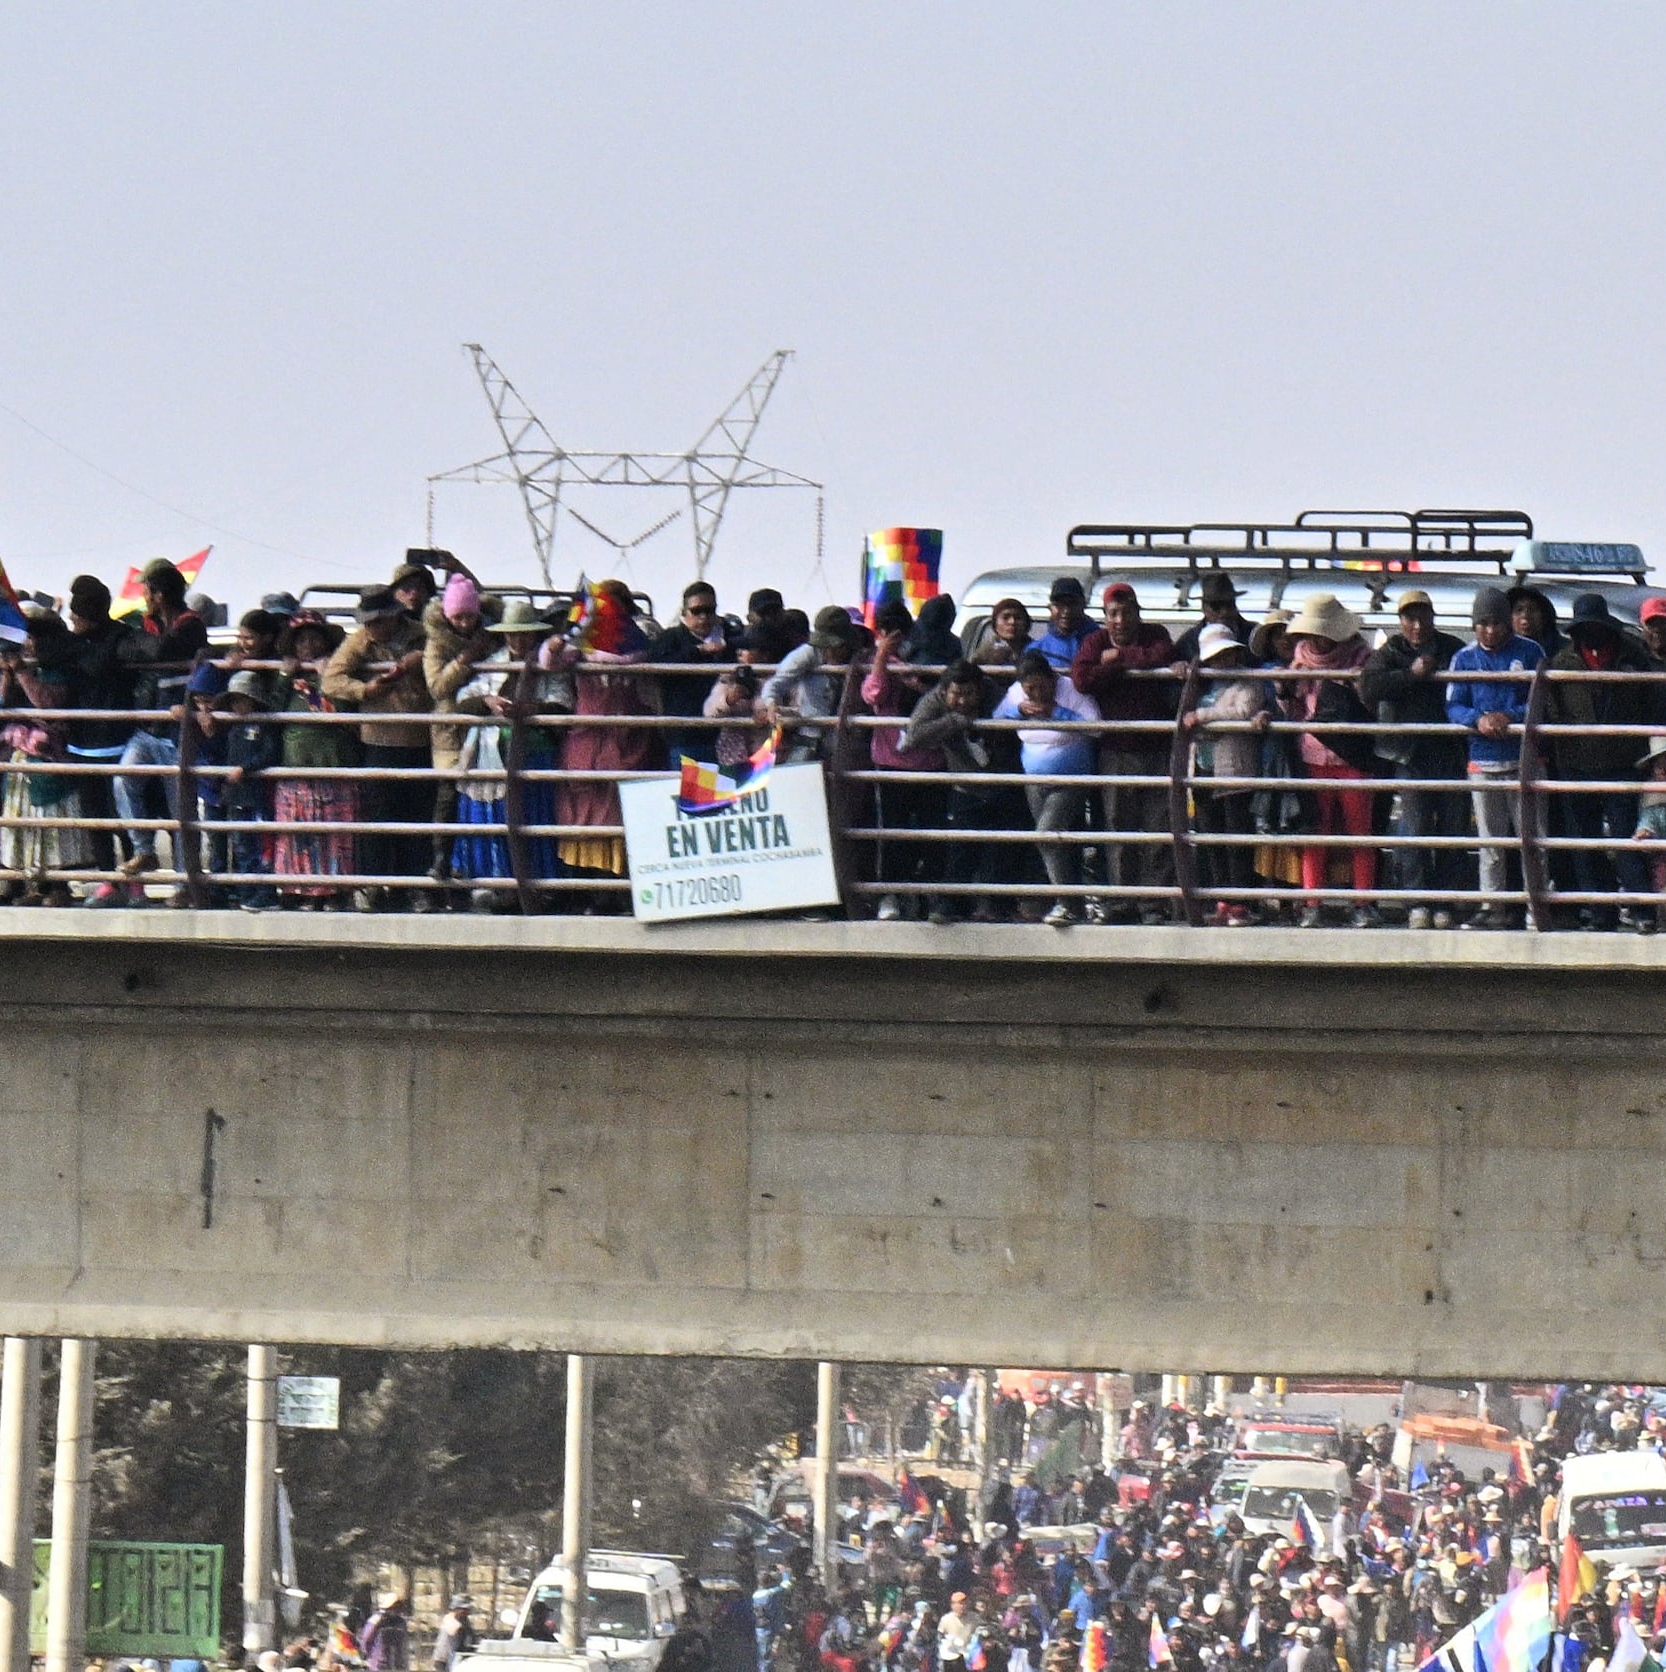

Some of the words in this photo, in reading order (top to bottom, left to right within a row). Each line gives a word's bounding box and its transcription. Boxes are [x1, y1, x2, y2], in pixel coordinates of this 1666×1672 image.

[666, 824, 699, 858] EN
[704, 814, 791, 854] VENTA
[653, 874, 743, 909] 71720680
